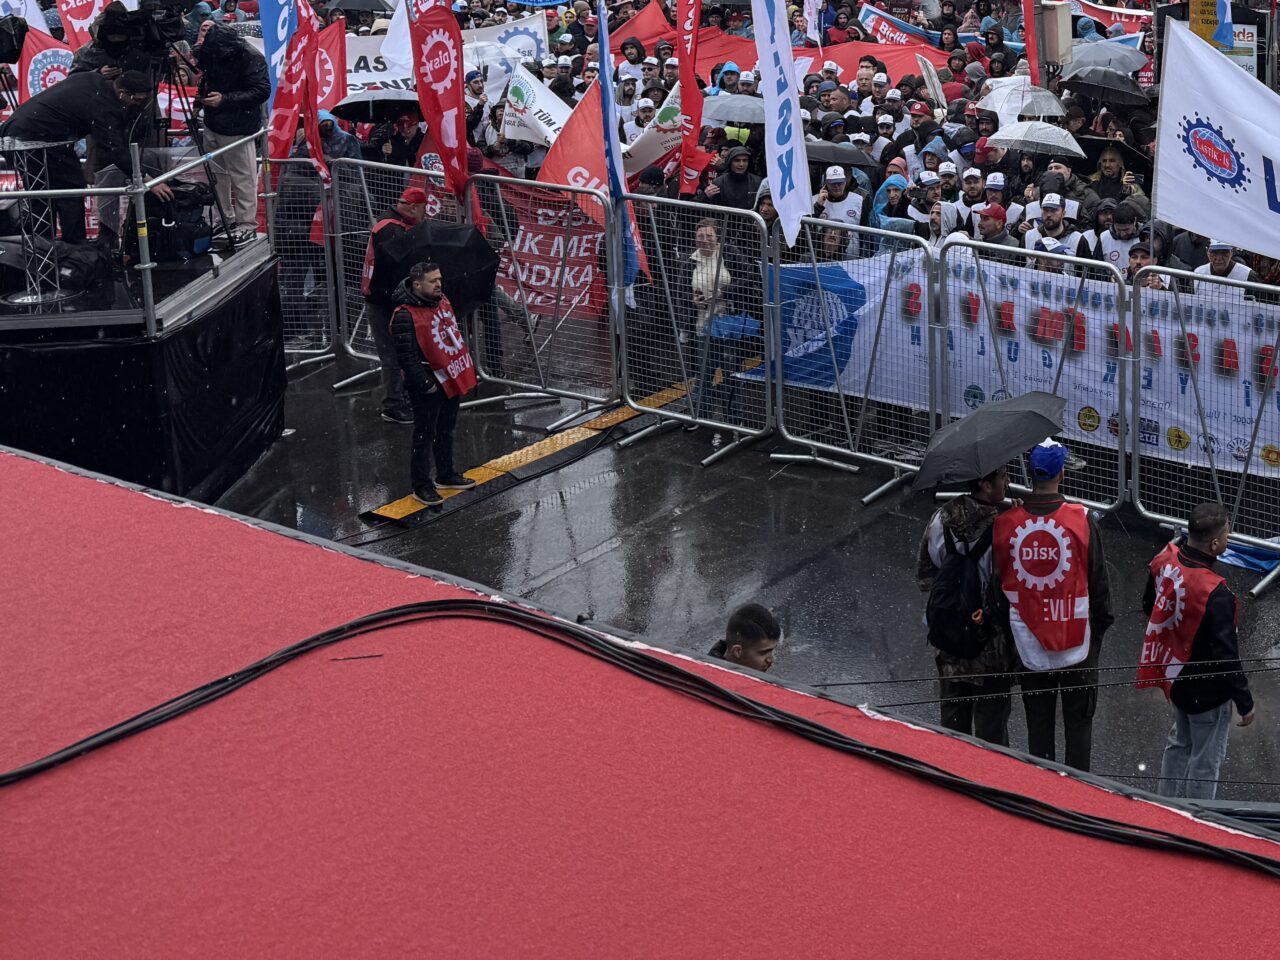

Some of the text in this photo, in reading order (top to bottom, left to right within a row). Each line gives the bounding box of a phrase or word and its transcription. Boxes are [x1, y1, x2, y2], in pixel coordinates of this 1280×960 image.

[878, 21, 909, 45] Birlik
[533, 108, 557, 129] TÜM
[496, 260, 600, 288] ENDİKA
[1021, 540, 1058, 562] DİSK
[1154, 586, 1175, 612] İSK
